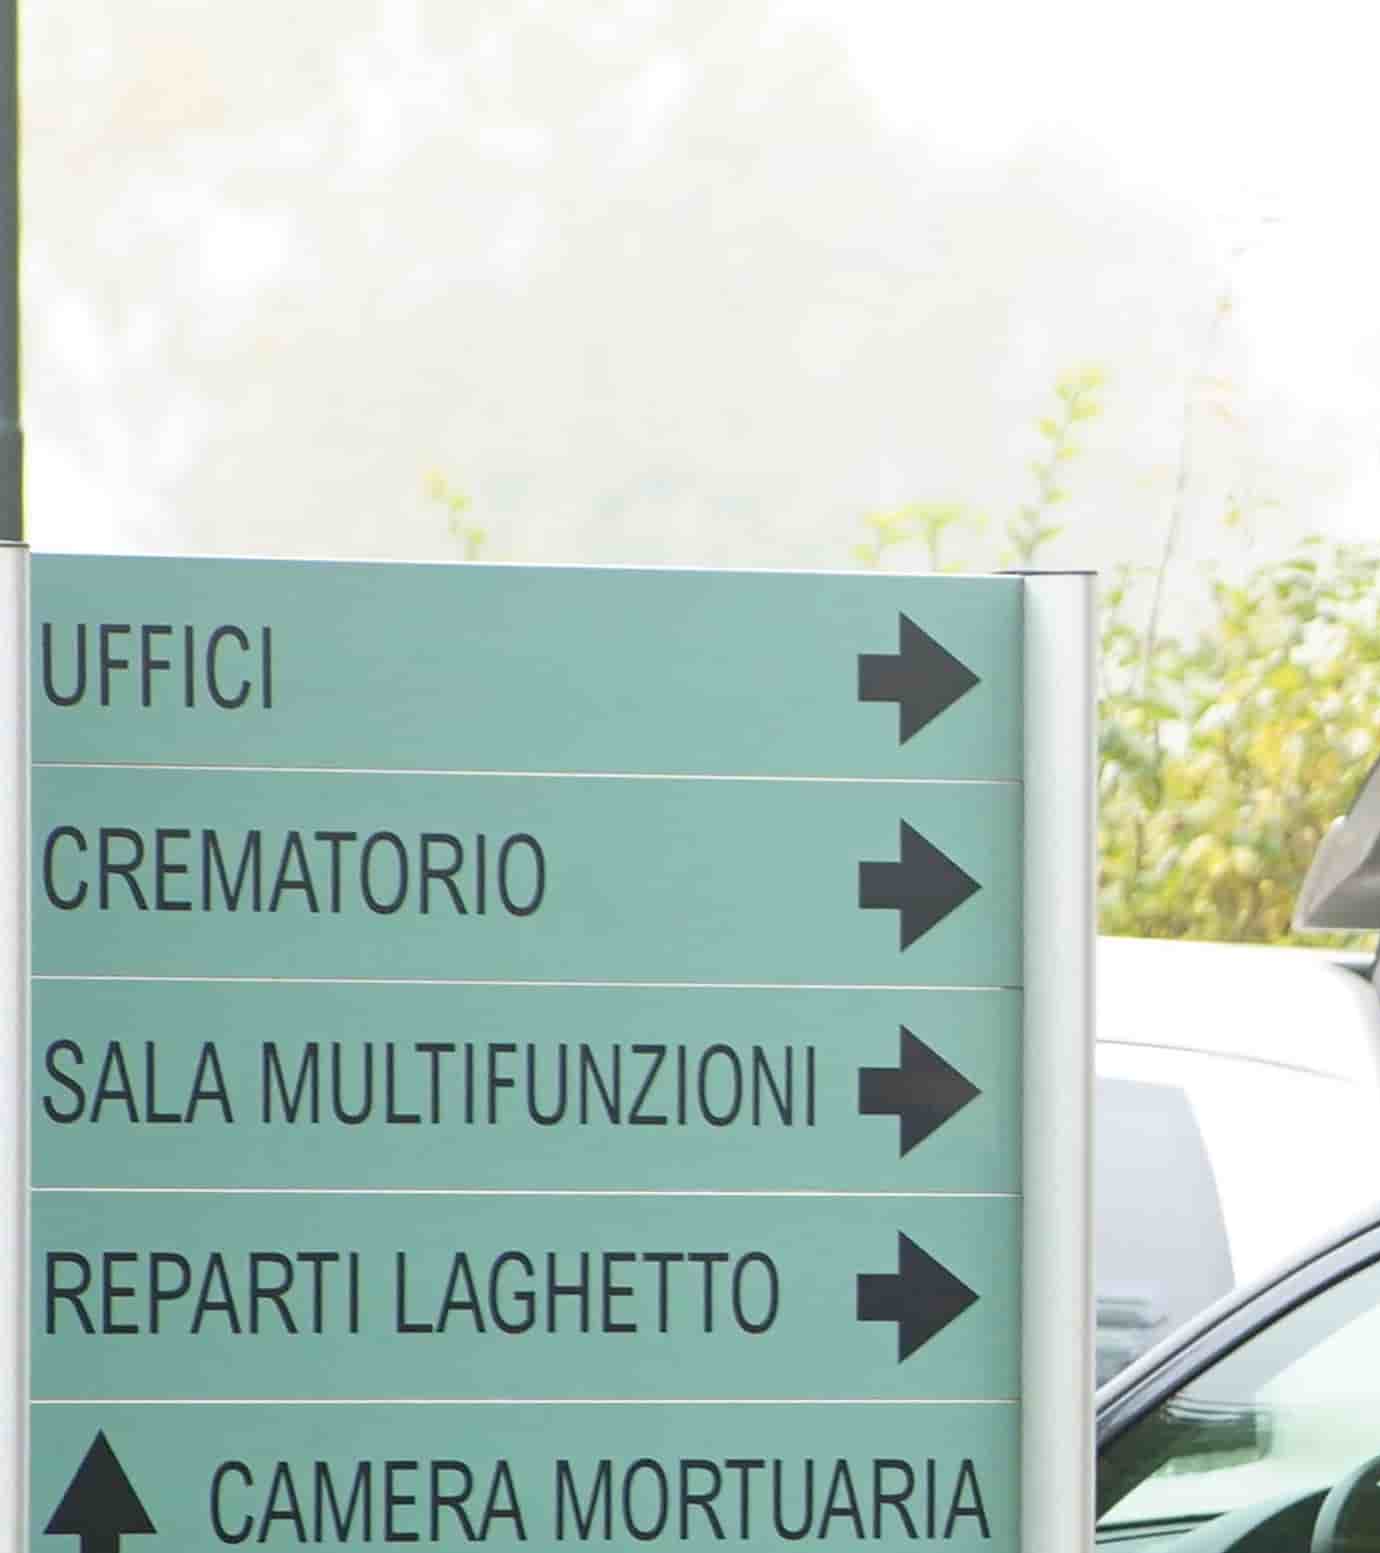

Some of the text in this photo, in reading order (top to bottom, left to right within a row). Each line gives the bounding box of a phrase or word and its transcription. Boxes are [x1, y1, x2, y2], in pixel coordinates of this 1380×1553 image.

[41, 621, 273, 711] UFFICI
[42, 824, 546, 918] CREMATORIO
[41, 1038, 816, 1128] SALA MULTIFUNZIONI
[44, 1250, 780, 1336] REPARTI LAGHETTO
[209, 1457, 993, 1546] CAMERA MORTUARIA
